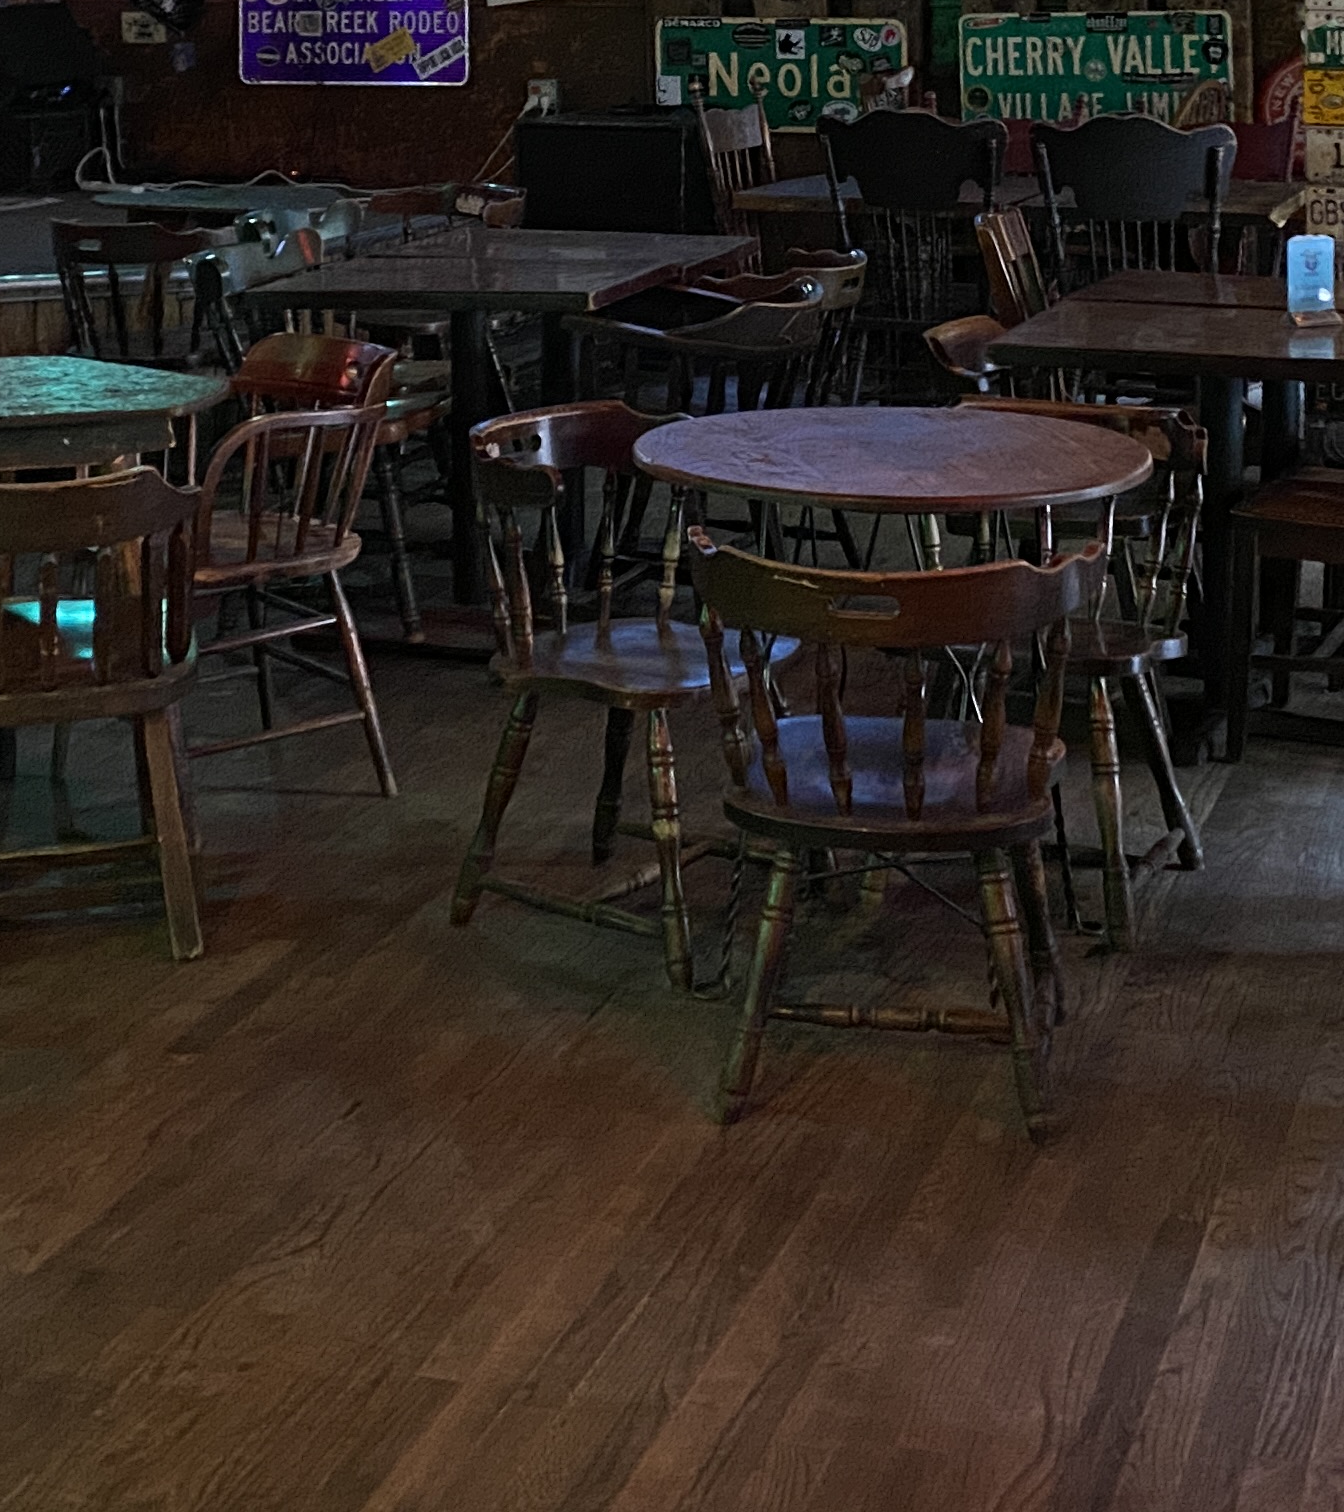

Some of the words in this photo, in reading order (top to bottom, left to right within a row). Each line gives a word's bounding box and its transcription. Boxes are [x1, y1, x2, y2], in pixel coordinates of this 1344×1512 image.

[314, 10, 379, 35] REEK
[388, 10, 460, 35] RODEO
[708, 51, 852, 99] Neola
[964, 35, 1087, 77] CHERRY
